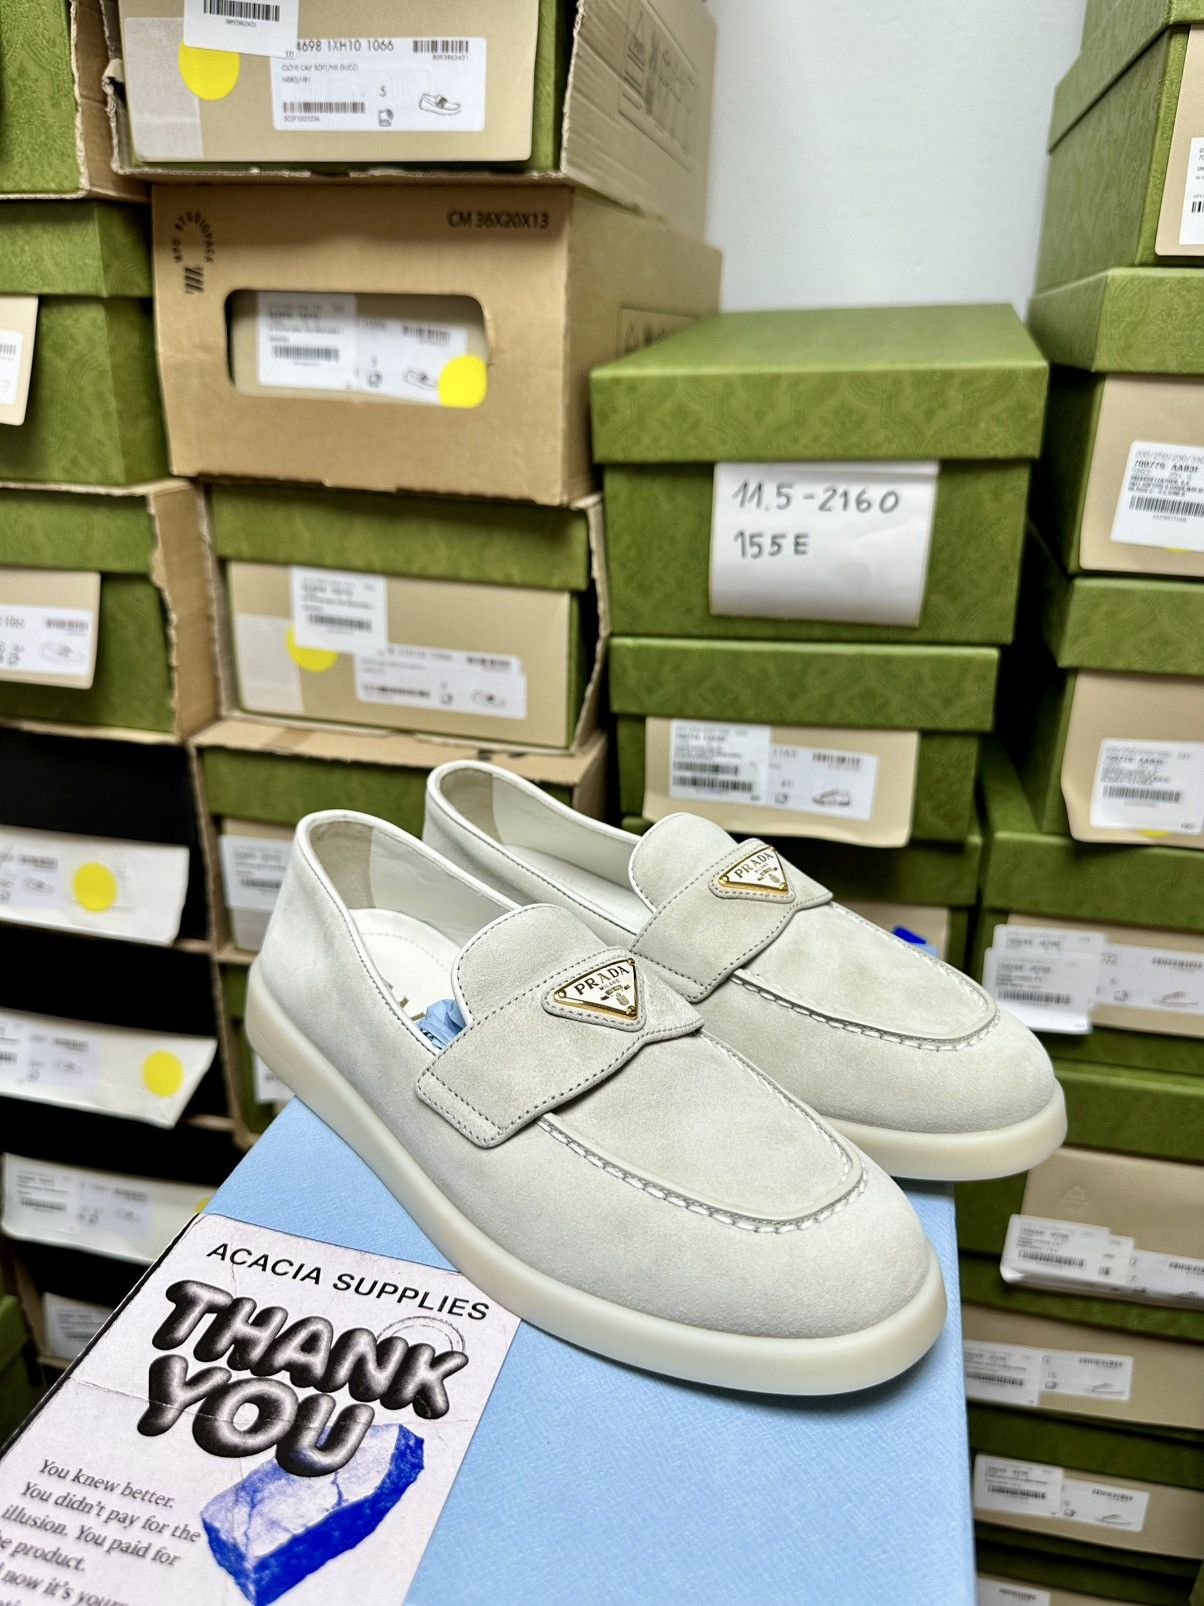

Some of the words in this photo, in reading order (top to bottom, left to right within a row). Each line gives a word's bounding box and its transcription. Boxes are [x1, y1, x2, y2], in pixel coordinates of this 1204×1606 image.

[367, 40, 394, 52] 1066
[447, 210, 472, 228] CM
[476, 211, 549, 229] 36X20X13
[734, 852, 775, 879] PRADA
[573, 965, 631, 996] PRADA
[598, 979, 621, 991] MILANO
[206, 1242, 322, 1286] ACACIA
[332, 1272, 490, 1321] SUPPLIES
[151, 1279, 469, 1420] THANK
[137, 1354, 374, 1478] YOU
[39, 1458, 70, 1480] You
[71, 1467, 120, 1493] knew
[120, 1481, 176, 1509] better.
[21, 1481, 53, 1503] You
[54, 1491, 106, 1517] didn't
[105, 1508, 140, 1529] pay
[140, 1515, 171, 1535] for
[171, 1523, 202, 1543] the
[1, 1503, 68, 1536] illusion.
[75, 1524, 106, 1546] You
[106, 1538, 154, 1560] paid
[151, 1547, 182, 1567] for
[10, 1540, 87, 1572] product.
[1, 1569, 43, 1591] now
[43, 1577, 74, 1600] it's
